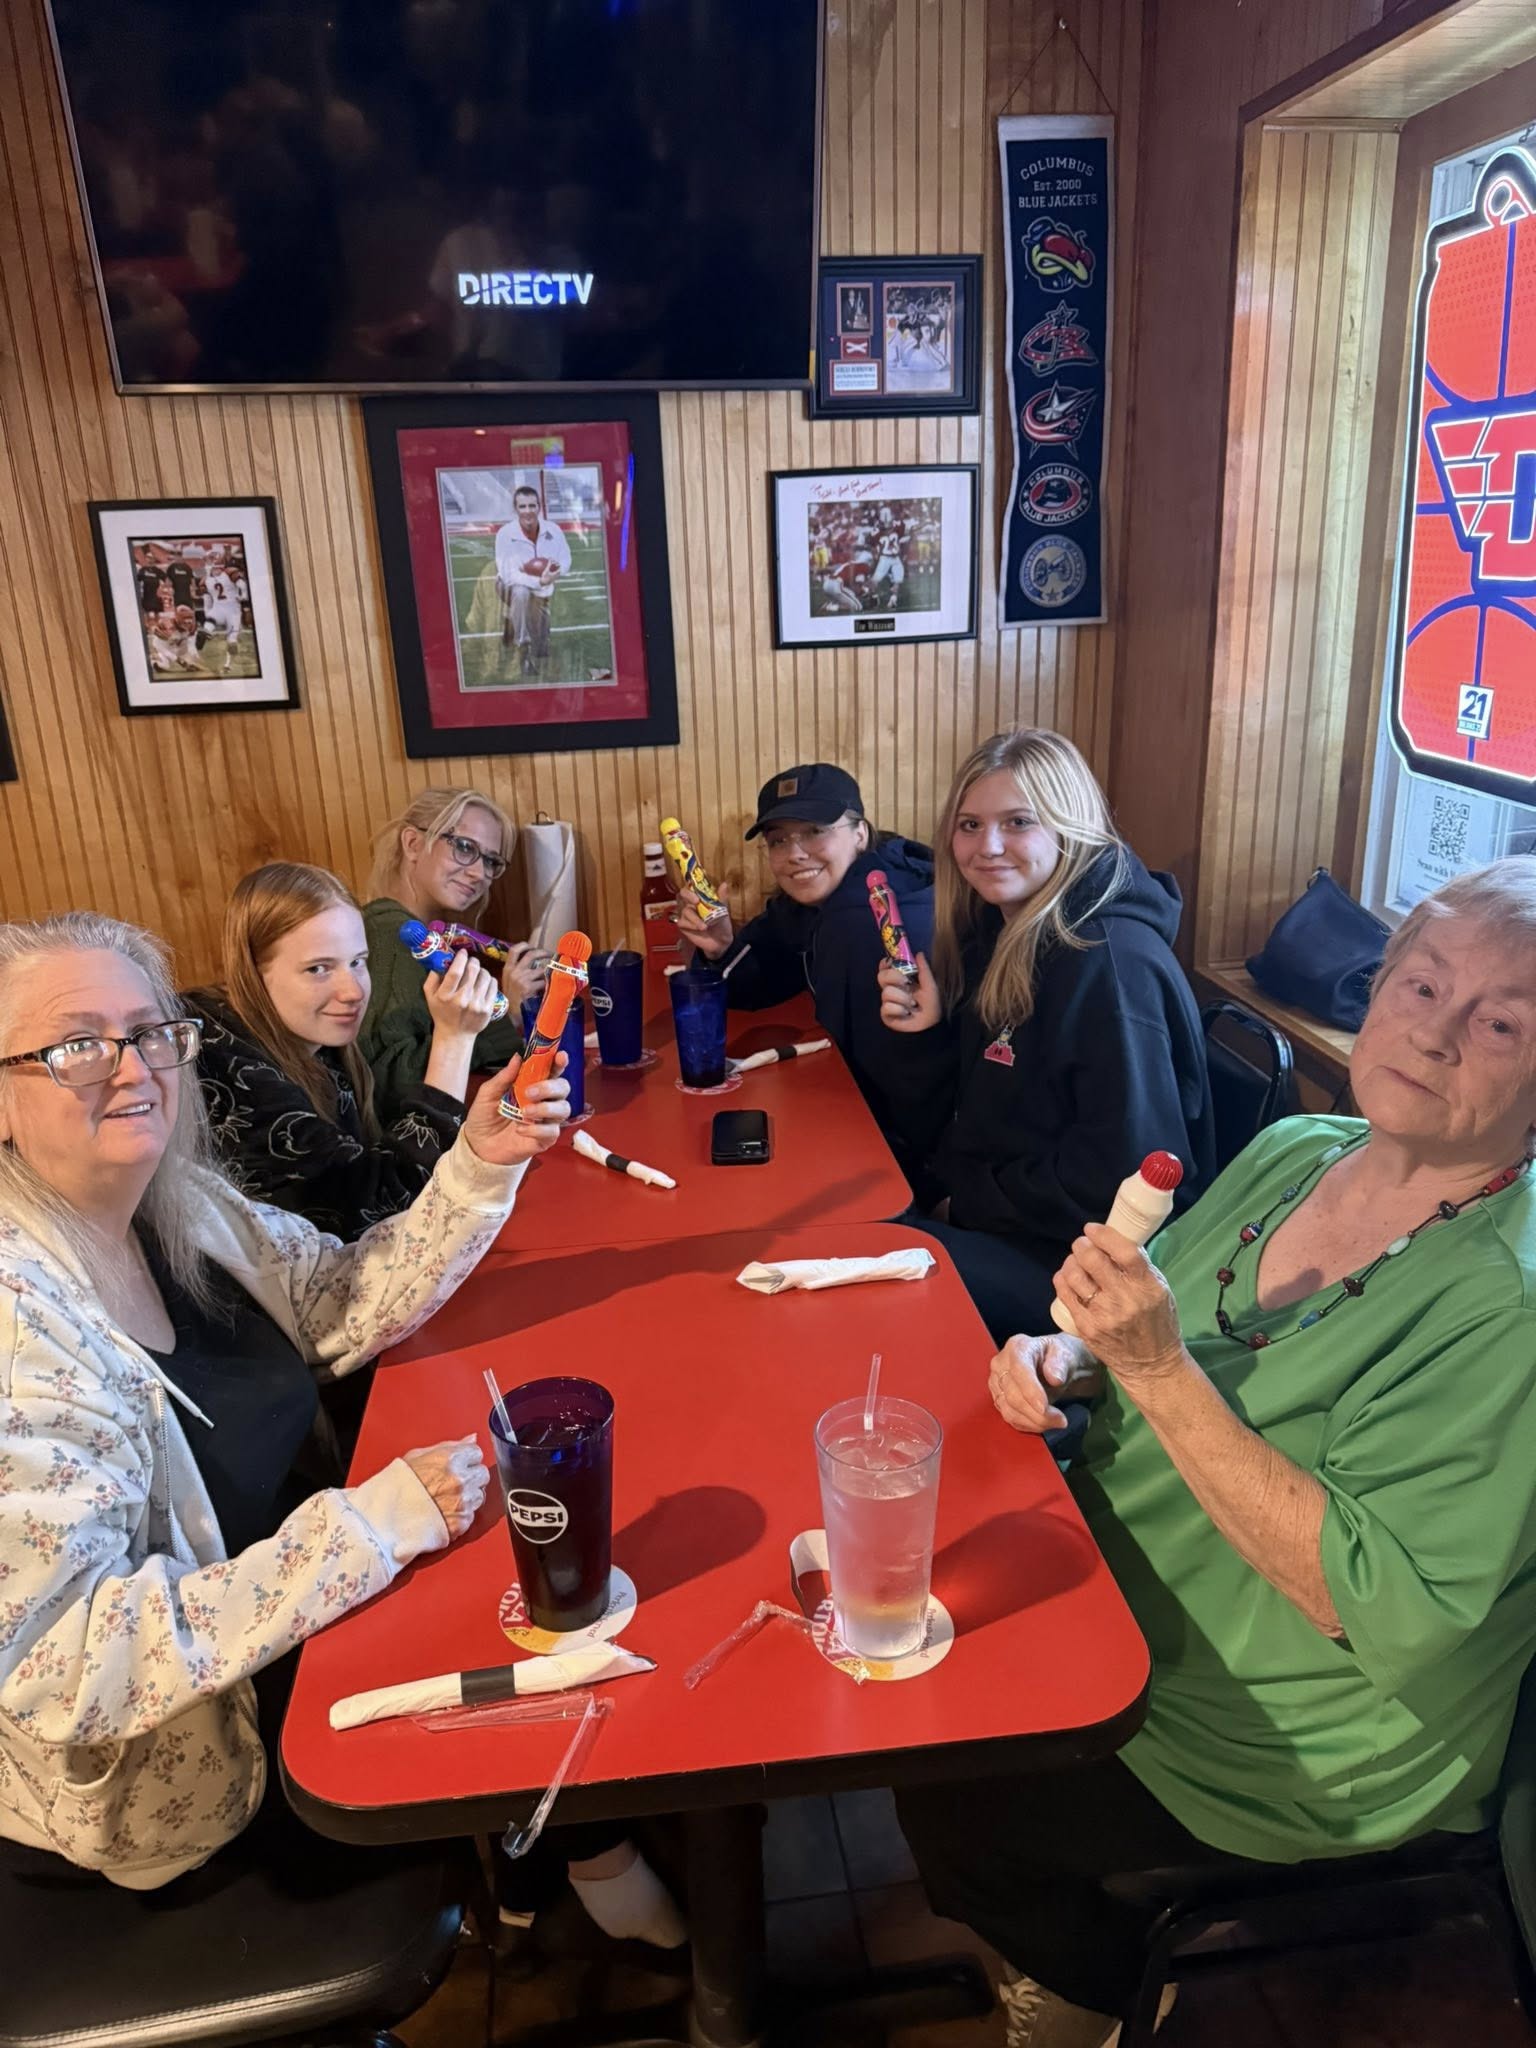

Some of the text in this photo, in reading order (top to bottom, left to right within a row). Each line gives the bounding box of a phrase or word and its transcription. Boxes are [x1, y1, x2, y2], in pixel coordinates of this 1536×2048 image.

[1020, 157, 1095, 180] COLUMBUS
[1056, 179, 1082, 190] 2000
[1019, 194, 1098, 208] BLUE JACKETS
[458, 273, 594, 305] DIRECTV
[1461, 690, 1488, 720] 21
[510, 1502, 564, 1524] PEPSI
